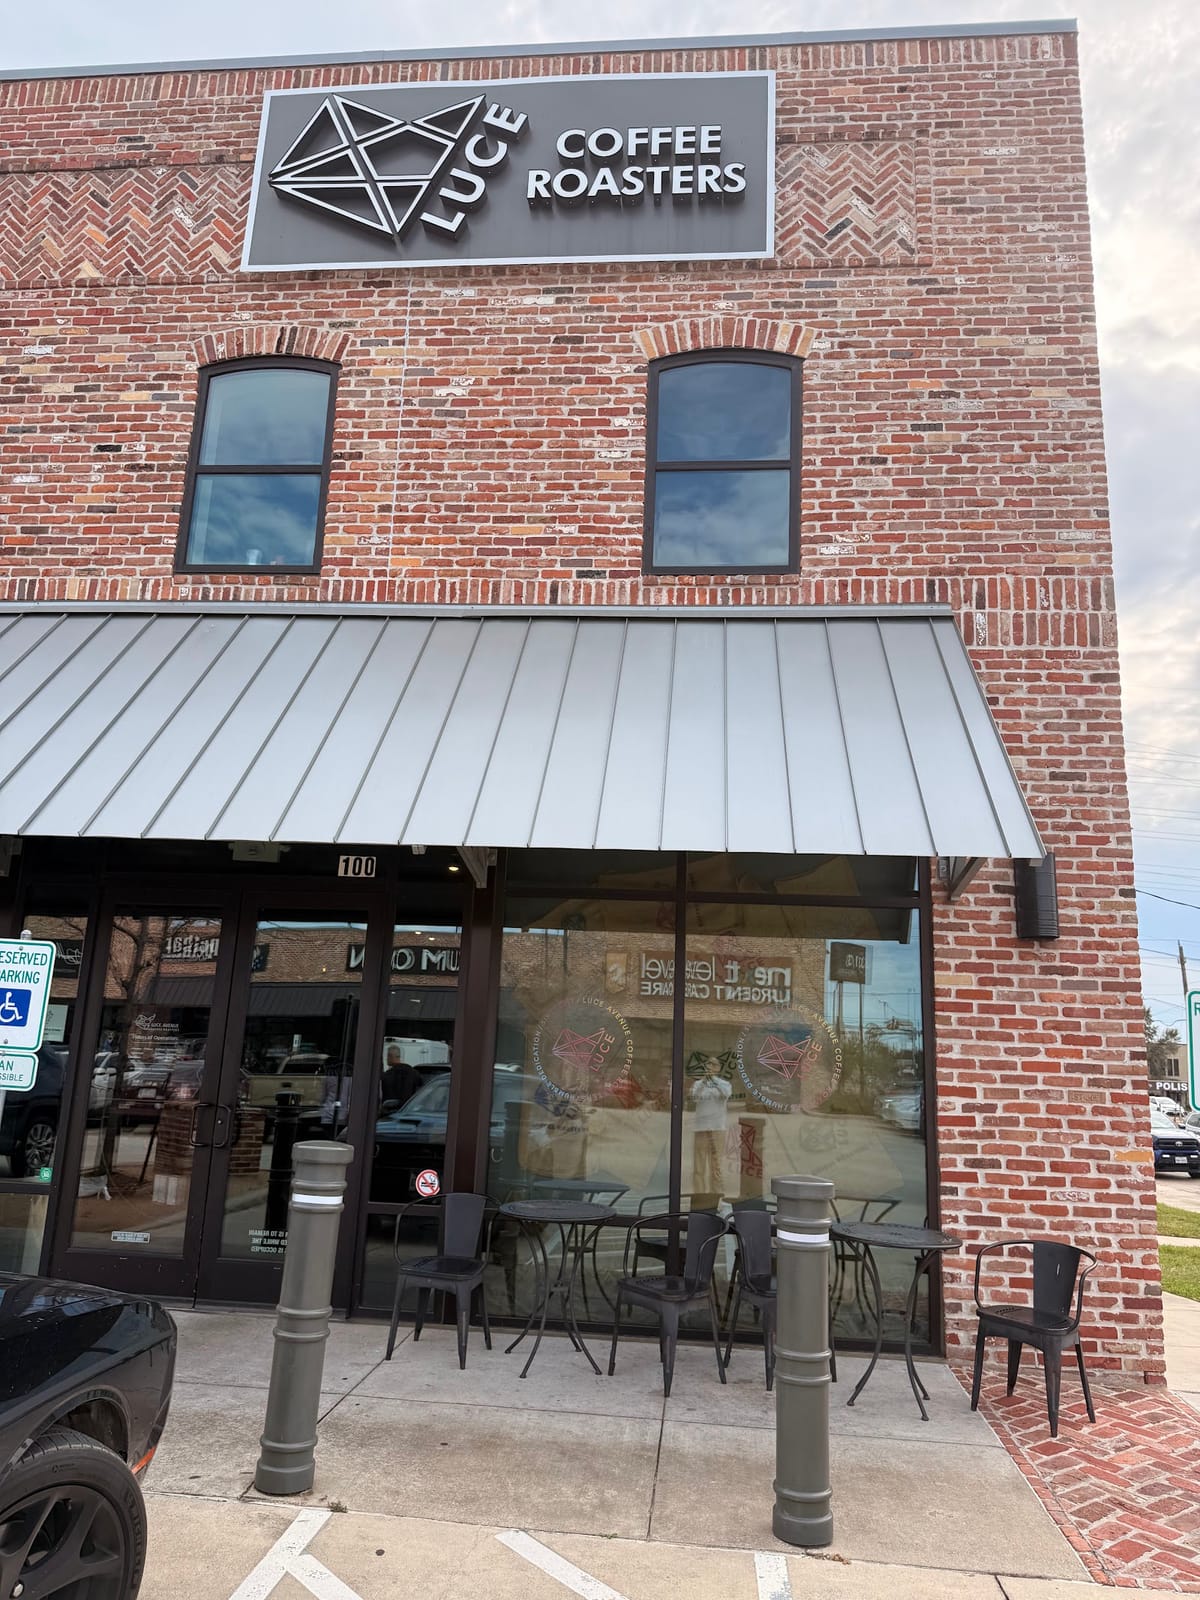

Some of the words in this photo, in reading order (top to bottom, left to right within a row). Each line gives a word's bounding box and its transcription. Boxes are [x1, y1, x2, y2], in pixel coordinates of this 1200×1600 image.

[556, 125, 722, 159] COFFEE
[420, 102, 528, 233] LUCE
[527, 163, 746, 199] ROASTERS
[342, 857, 375, 876] 100
[0, 951, 48, 966] ESERVED
[0, 969, 40, 984] ARKING
[606, 1006, 631, 1036] AVENUE
[621, 1039, 634, 1076] COFFEE
[813, 1013, 839, 1044] AVENUE
[0, 1060, 14, 1071] AN
[533, 1031, 547, 1081] DEDICATION
[591, 1033, 616, 1072] LUCE
[736, 1038, 753, 1089] DEDICATION
[797, 1042, 823, 1080] LUCE
[0, 1073, 24, 1081] SIBLE
